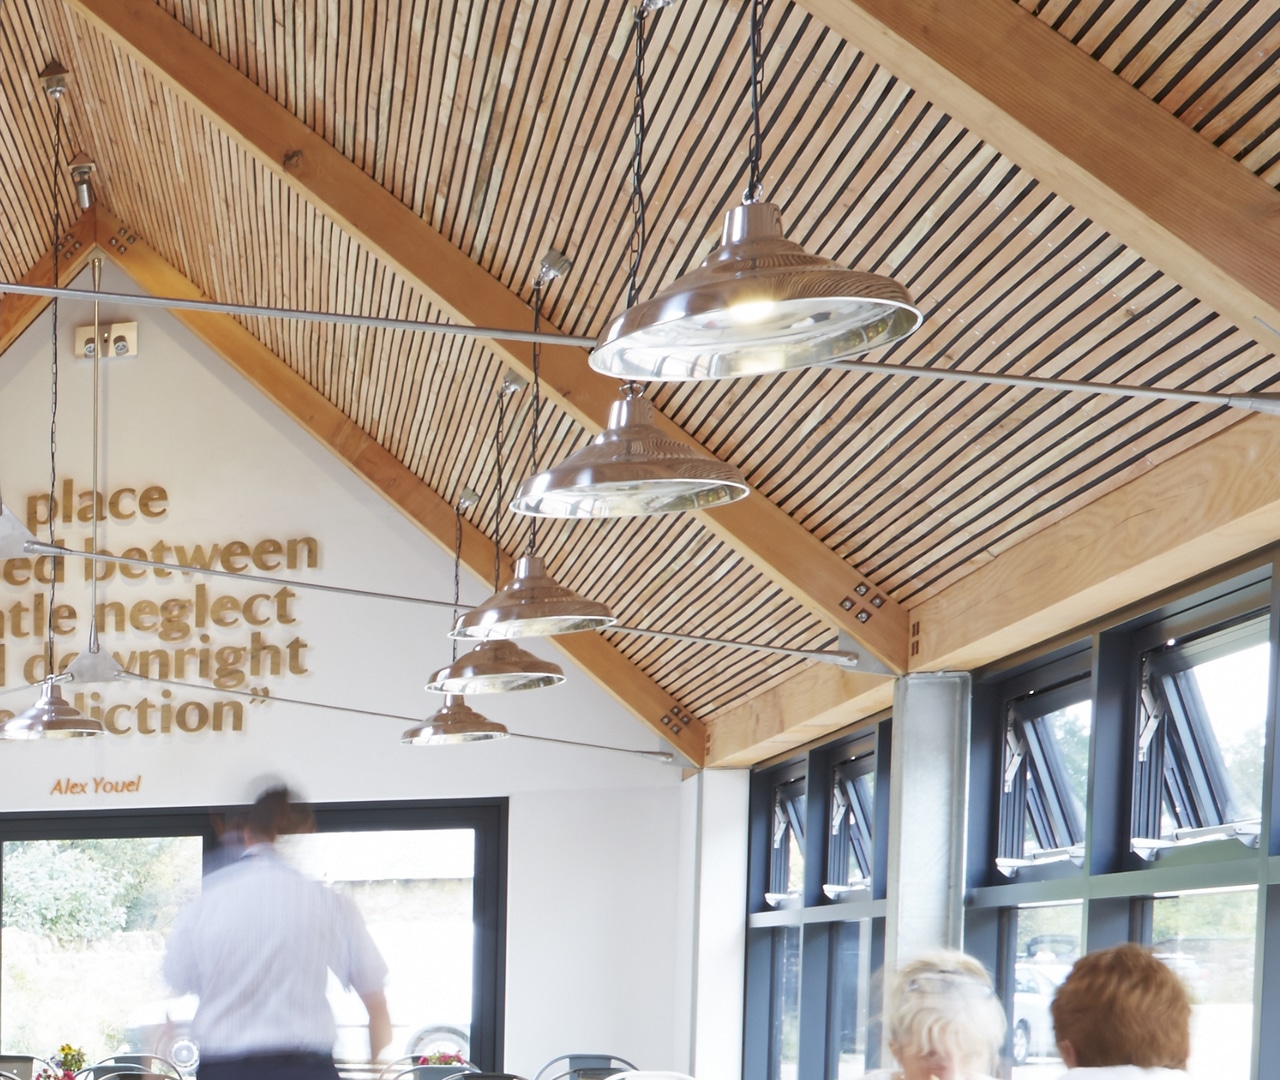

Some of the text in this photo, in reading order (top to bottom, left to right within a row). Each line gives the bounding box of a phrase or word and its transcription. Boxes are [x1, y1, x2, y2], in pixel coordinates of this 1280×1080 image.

[27, 478, 169, 536] place
[85, 535, 318, 581] between
[96, 583, 297, 641] neglect
[49, 774, 142, 795] Alex Youel
